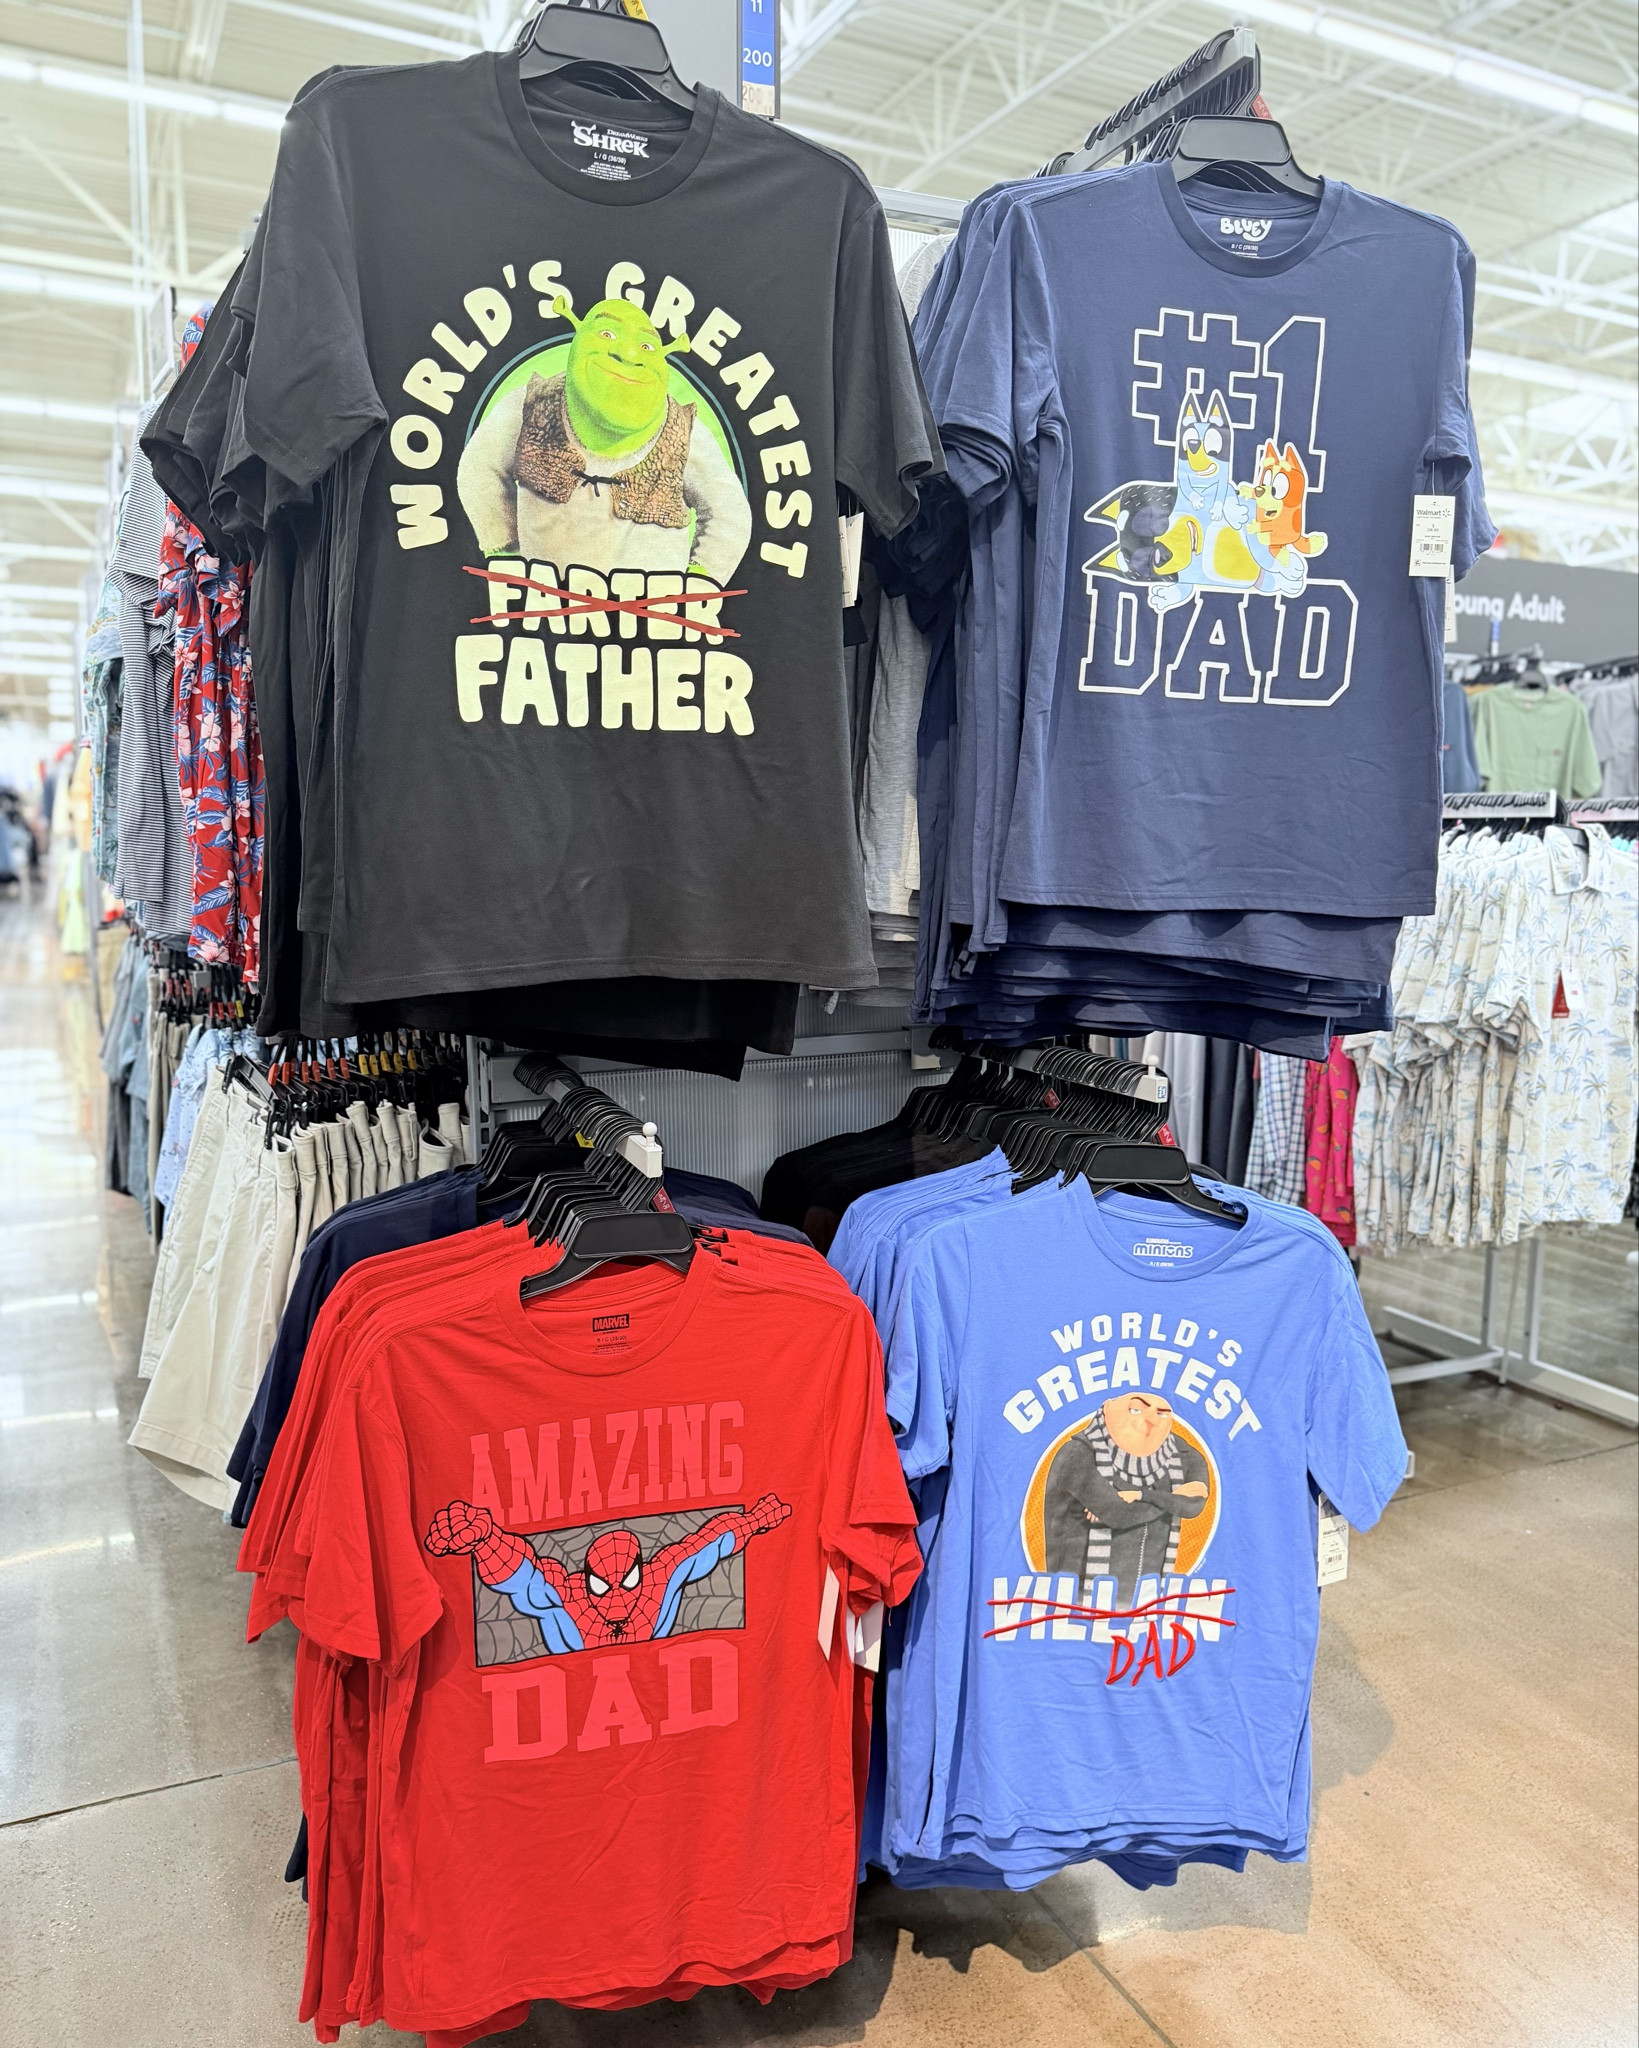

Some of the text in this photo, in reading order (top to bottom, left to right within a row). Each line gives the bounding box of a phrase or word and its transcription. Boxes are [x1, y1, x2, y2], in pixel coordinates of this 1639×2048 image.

[743, 47, 773, 68] 200
[1220, 217, 1273, 242] BLUEY
[390, 260, 812, 579] WORLD'S GREATEST
[1132, 307, 1328, 493] #1
[1416, 509, 1442, 517] Walmart
[486, 559, 725, 645] FARTER
[1078, 571, 1359, 707] DAD
[1455, 592, 1566, 625] oung Adult
[455, 634, 754, 736] FATHER
[594, 1315, 629, 1331] MARVEL
[1050, 1312, 1242, 1367] WORLD'S
[1002, 1347, 1262, 1442] GREATEST
[470, 1400, 747, 1525] AMAZING
[992, 1574, 1228, 1644] VILLAIN
[1105, 1621, 1196, 1687] DAD
[480, 1640, 740, 1765] DAD
